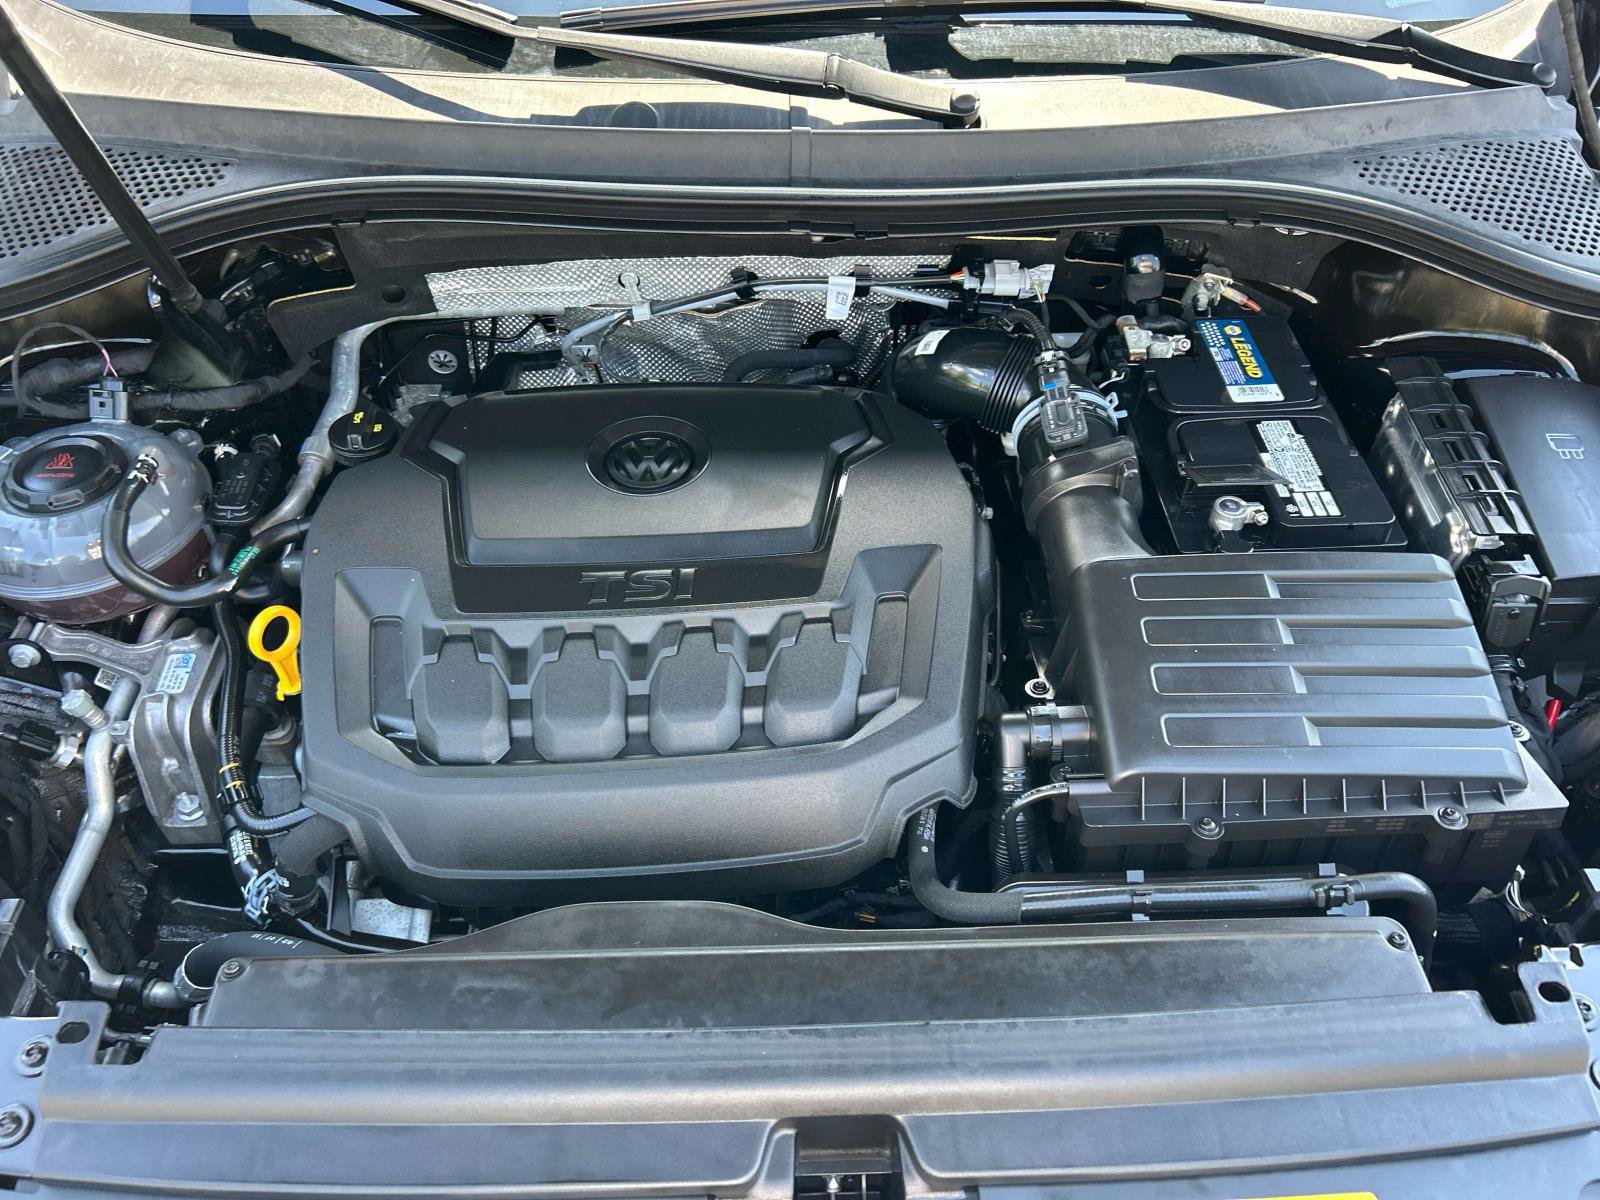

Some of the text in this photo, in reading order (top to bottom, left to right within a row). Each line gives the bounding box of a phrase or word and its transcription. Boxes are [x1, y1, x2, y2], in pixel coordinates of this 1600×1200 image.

[1230, 337, 1264, 379] LEGEND
[607, 436, 693, 489] VW
[579, 566, 699, 605] TSI
